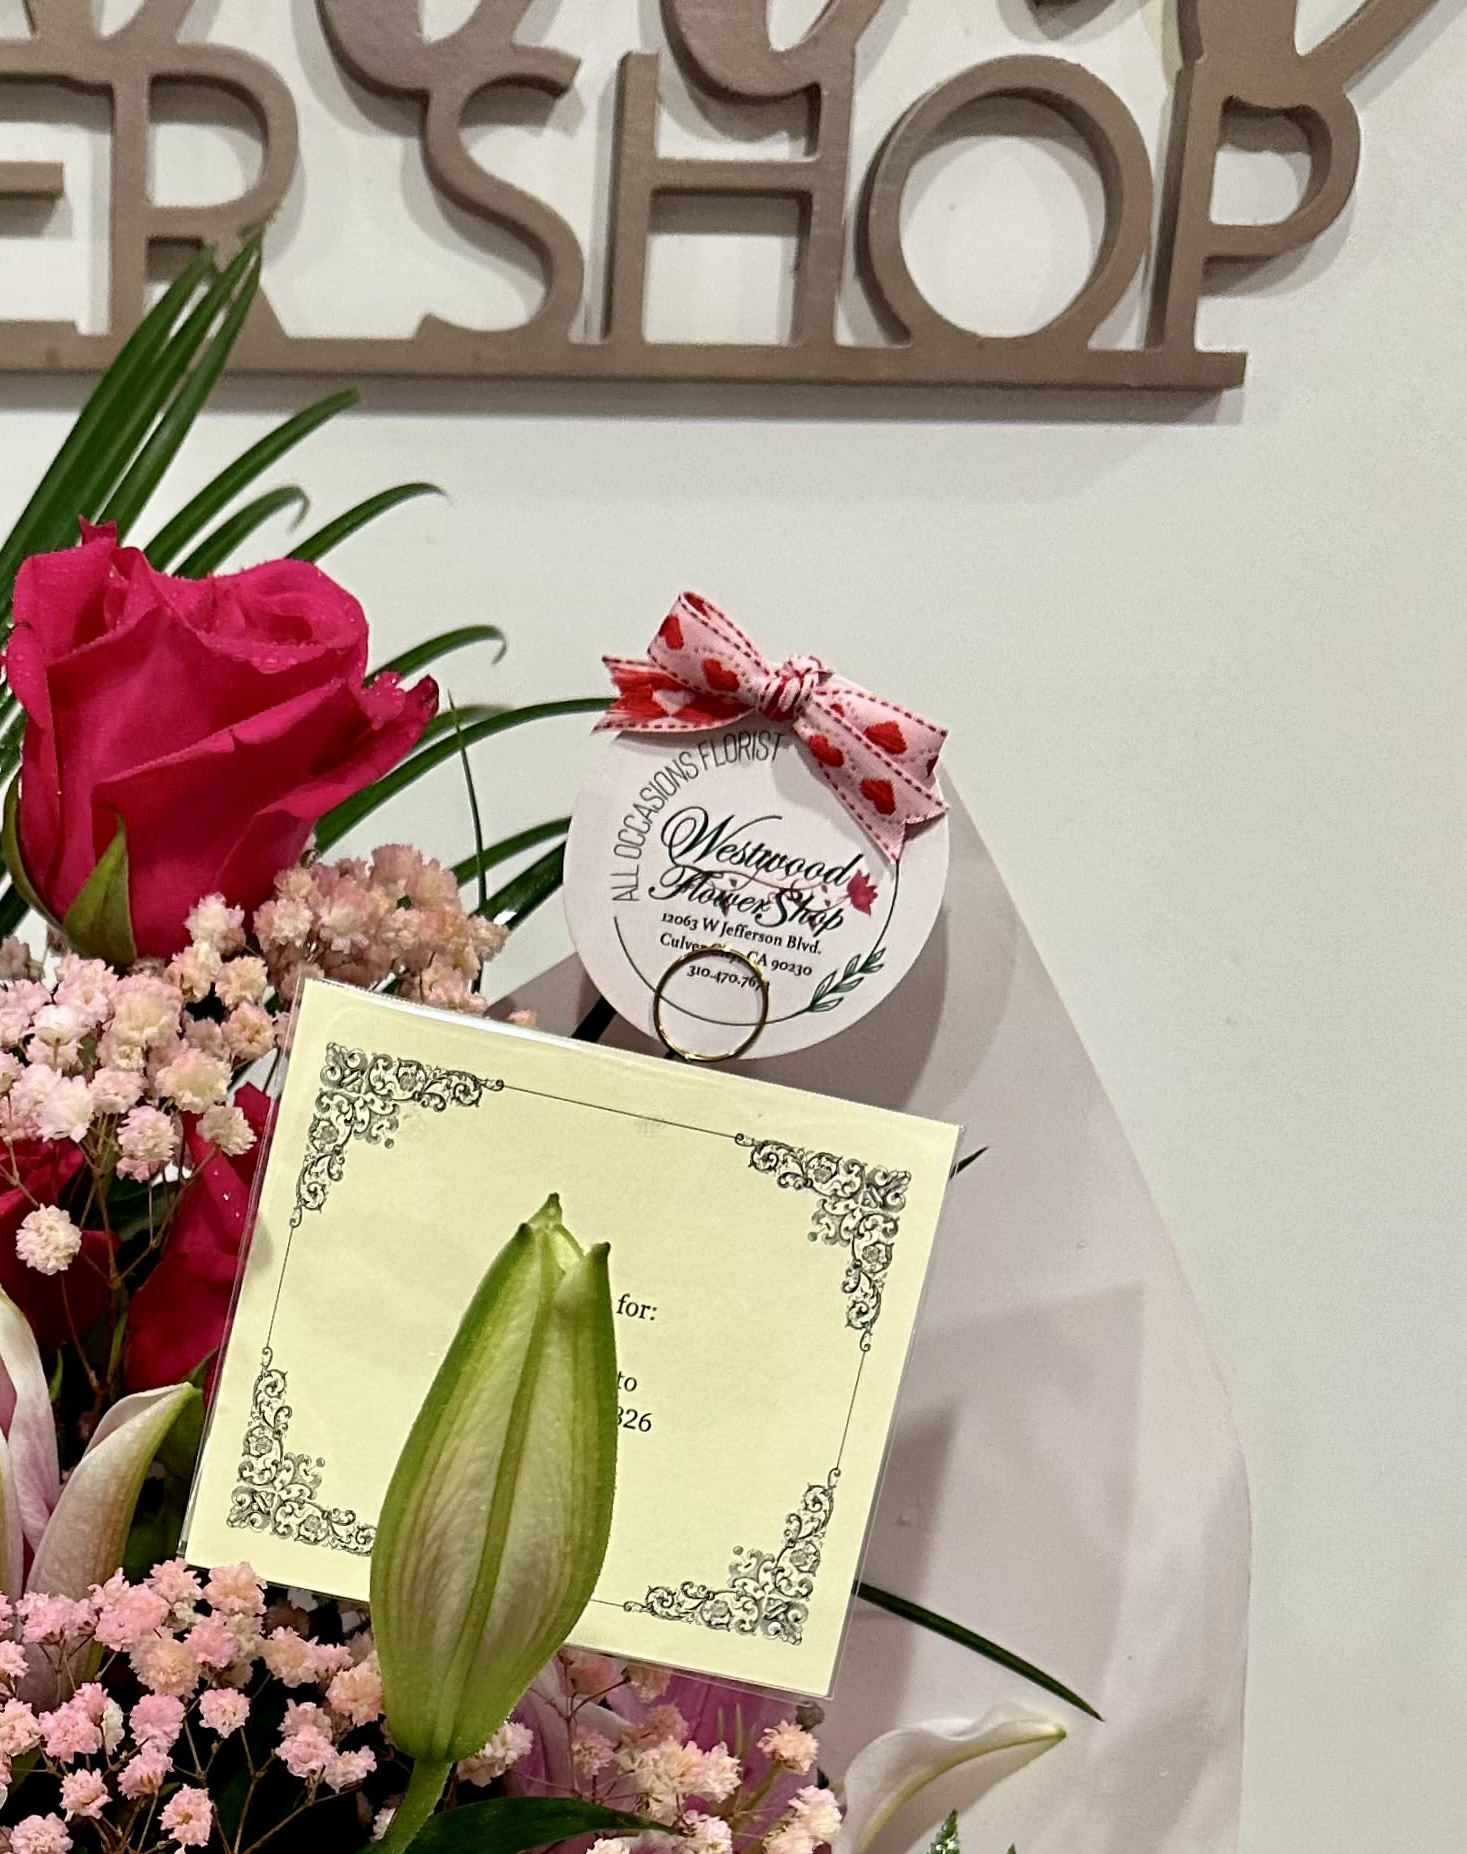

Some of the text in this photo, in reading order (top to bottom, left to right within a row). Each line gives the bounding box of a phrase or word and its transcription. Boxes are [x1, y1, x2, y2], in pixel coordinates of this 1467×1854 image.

[413, 42, 1362, 354] SHOP
[610, 730, 785, 902] ALL OCCASIONS FLORIST
[660, 806, 864, 887] Westwood
[660, 912, 822, 955] 12063 W Jefferson Blvd.
[686, 965, 770, 992] 310.470.76
[771, 959, 813, 977] 90230
[616, 1293, 658, 1321] for:
